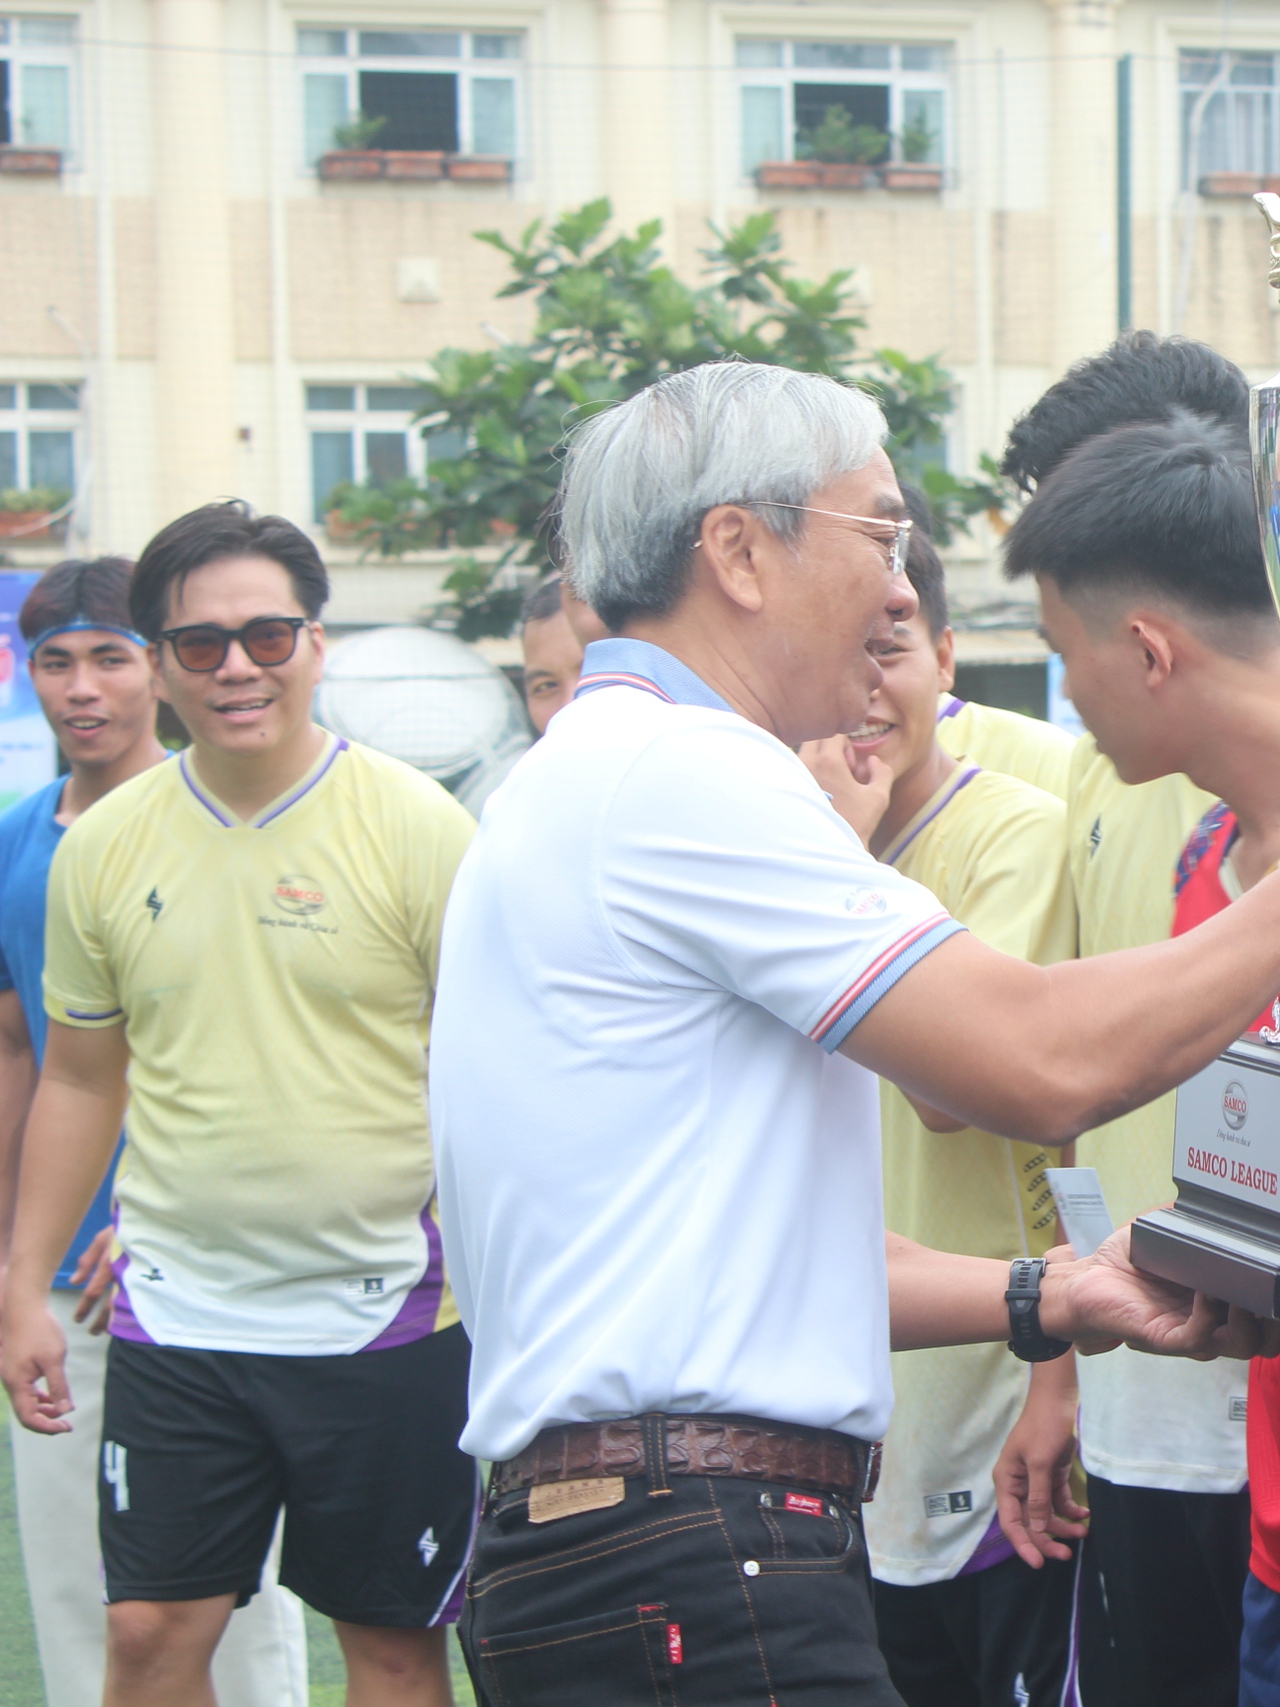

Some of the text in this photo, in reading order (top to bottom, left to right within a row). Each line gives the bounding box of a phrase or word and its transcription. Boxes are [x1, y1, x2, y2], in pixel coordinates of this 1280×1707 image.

[276, 885, 324, 903] SAMCO
[1223, 1095, 1247, 1113] SAMCO
[1187, 1146, 1278, 1195] SAMCO LEAGUE
[103, 1439, 131, 1512] 4
